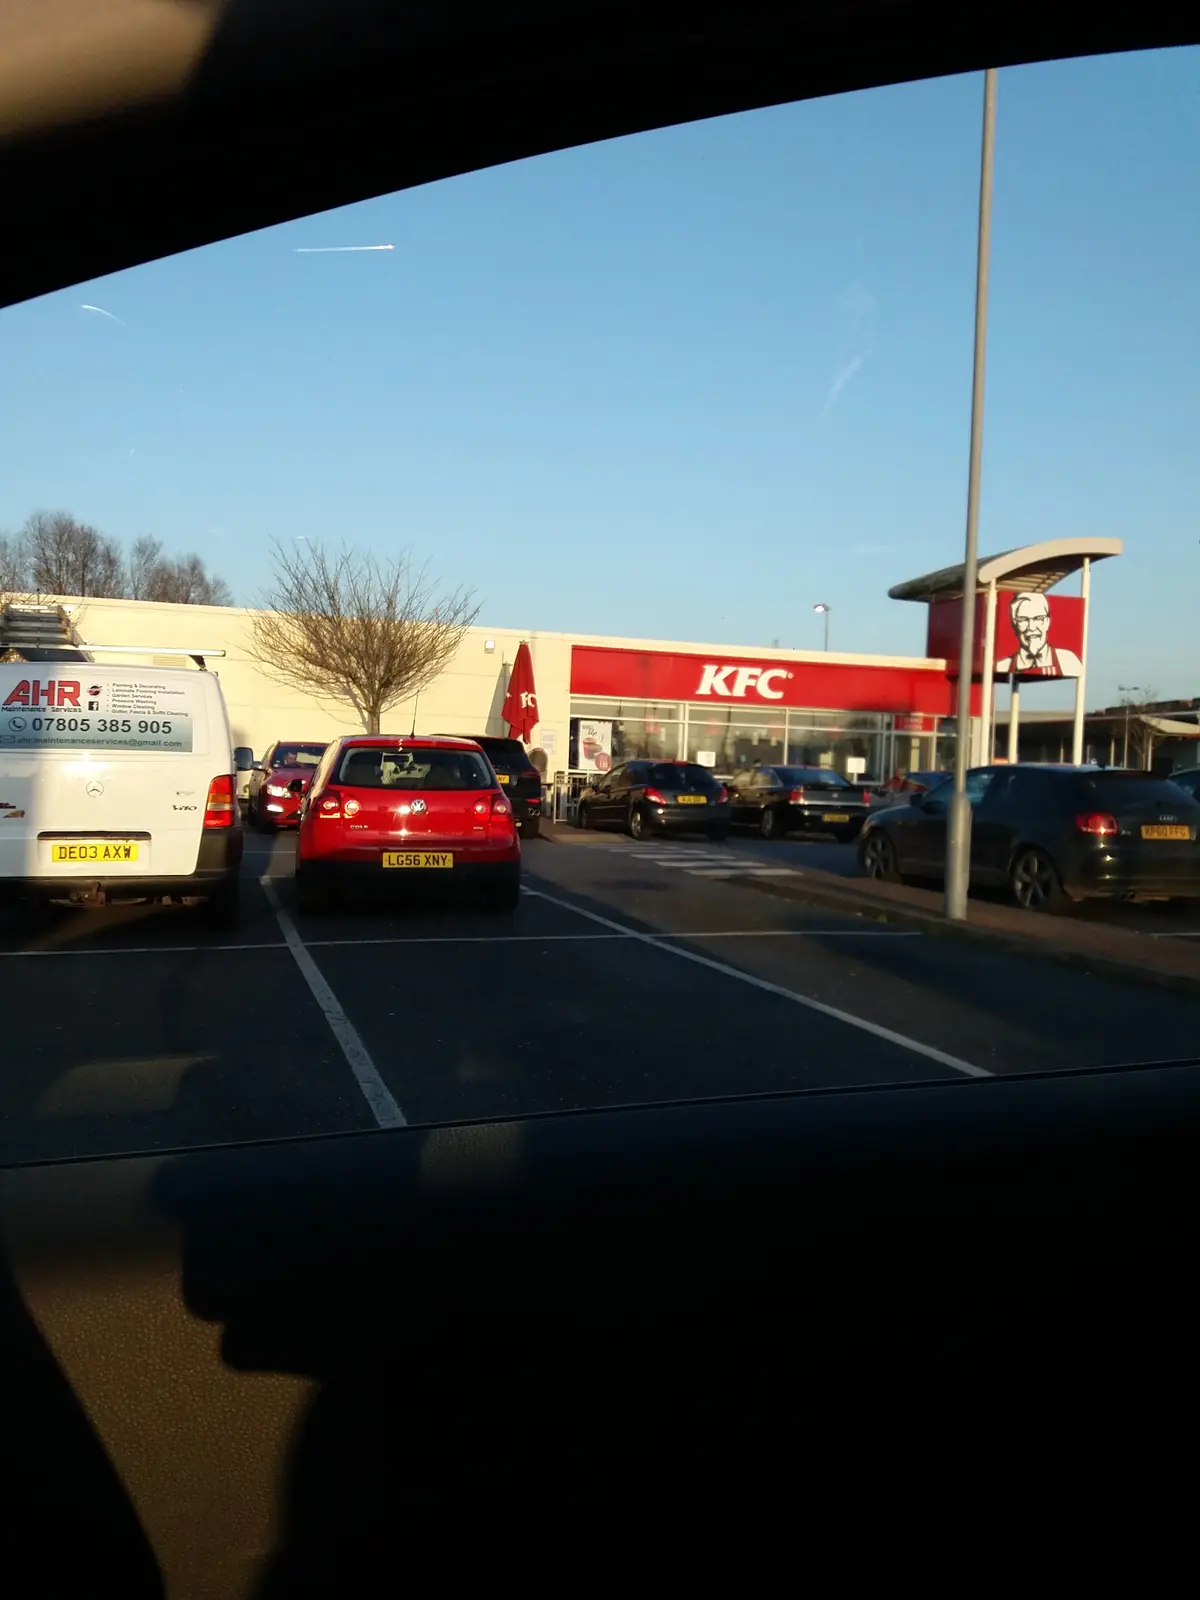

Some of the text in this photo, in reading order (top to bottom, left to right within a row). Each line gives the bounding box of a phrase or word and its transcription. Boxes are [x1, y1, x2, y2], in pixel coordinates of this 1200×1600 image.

[695, 664, 787, 699] KFC
[2, 679, 82, 706] AHR
[32, 718, 173, 734] 07805 385 905
[58, 845, 132, 859] DE03 AXW
[387, 854, 448, 866] LG56 XNY
